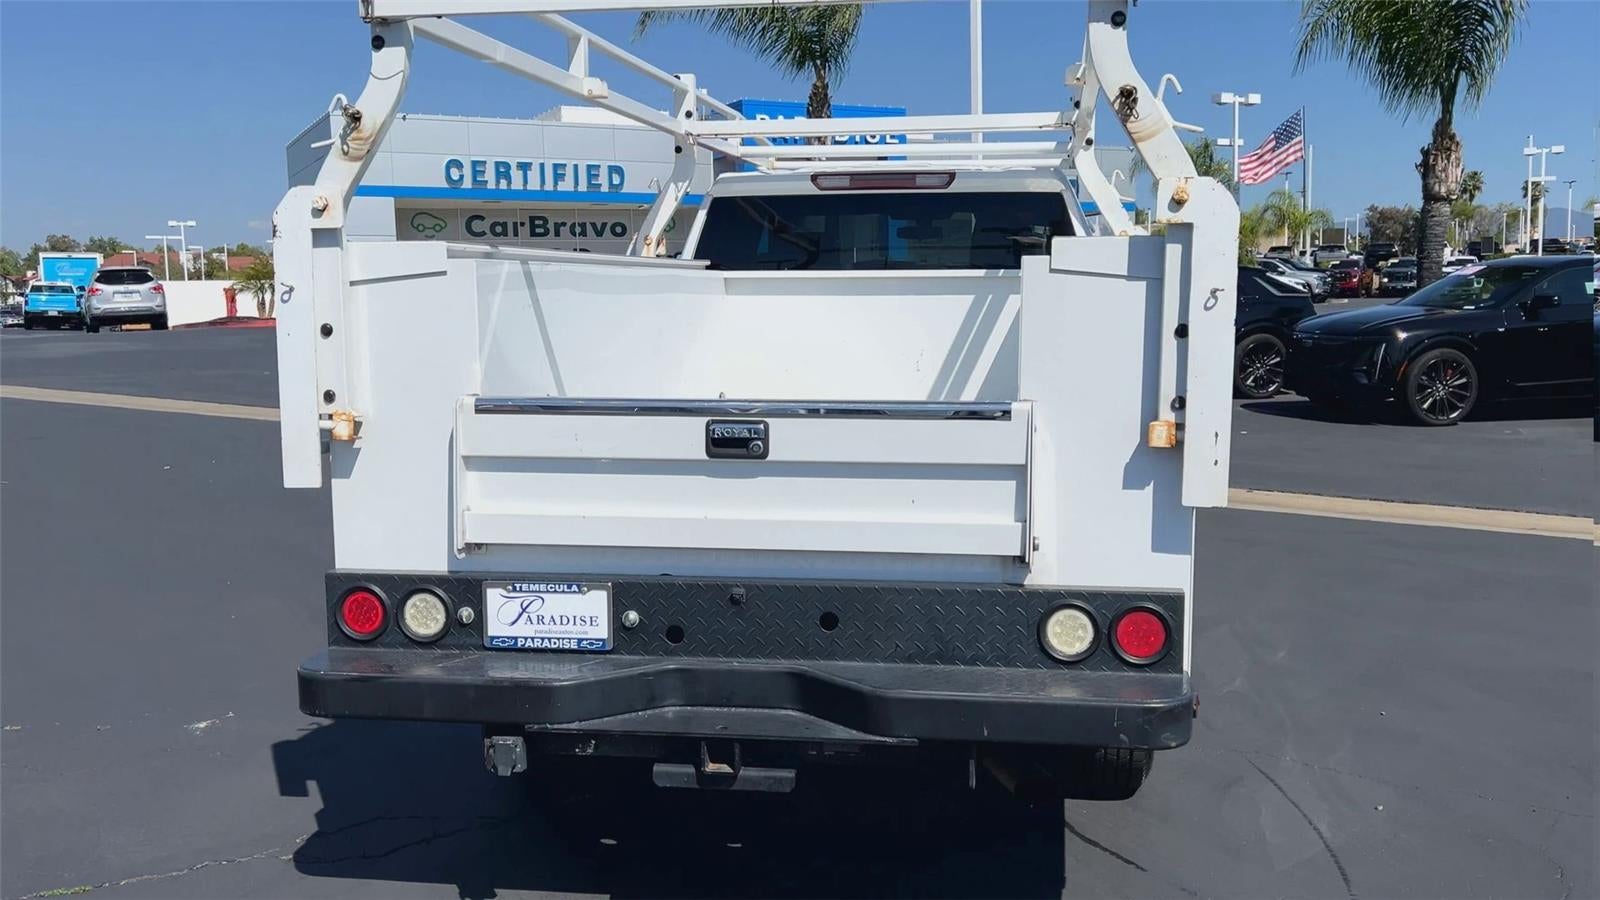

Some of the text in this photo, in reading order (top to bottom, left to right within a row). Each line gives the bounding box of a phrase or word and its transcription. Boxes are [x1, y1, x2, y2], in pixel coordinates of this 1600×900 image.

[445, 158, 625, 191] CERTIFIED
[465, 214, 627, 238] CarBravo
[714, 428, 758, 438] ROYAL
[514, 583, 579, 592] TEMECULA
[497, 593, 599, 627] PARADISE
[517, 638, 578, 649] PARADISE
